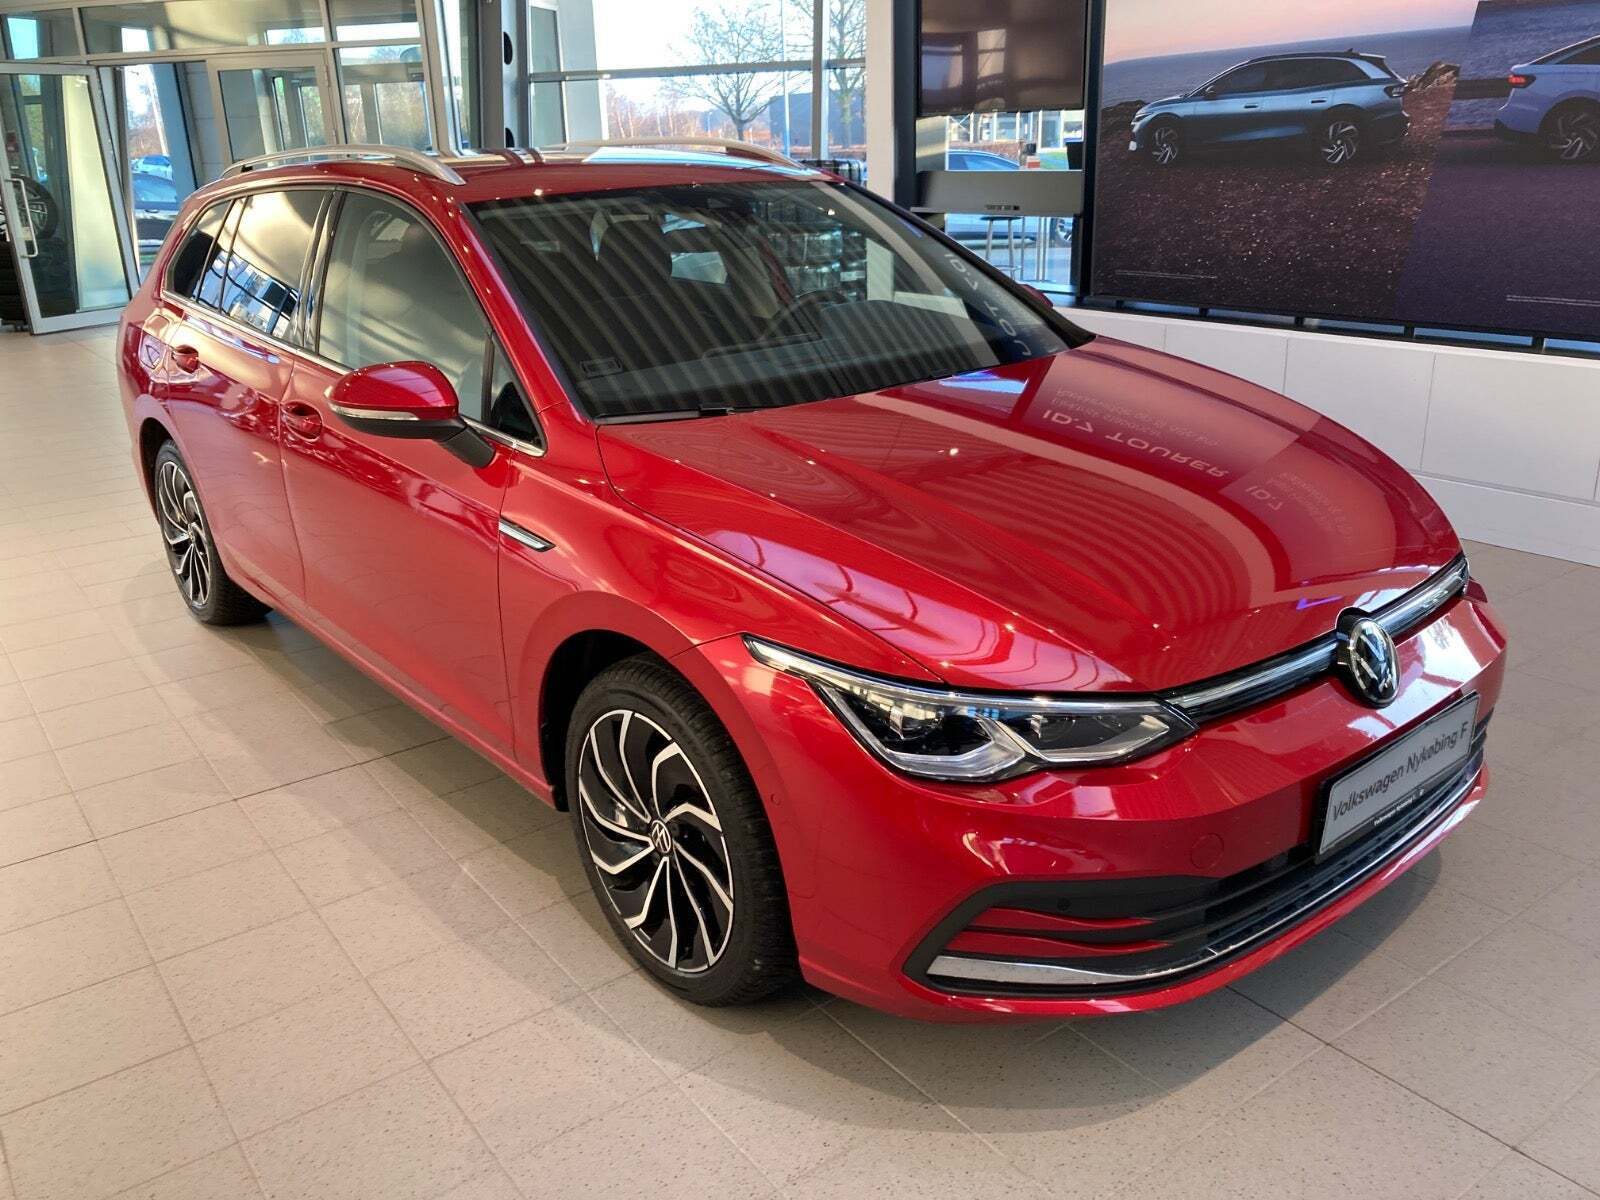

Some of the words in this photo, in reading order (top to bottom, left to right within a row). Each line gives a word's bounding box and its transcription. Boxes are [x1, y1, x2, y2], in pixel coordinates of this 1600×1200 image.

[1333, 765, 1404, 821] Volkswagen
[1405, 731, 1458, 774] Nykøbing
[1459, 721, 1470, 739] F
